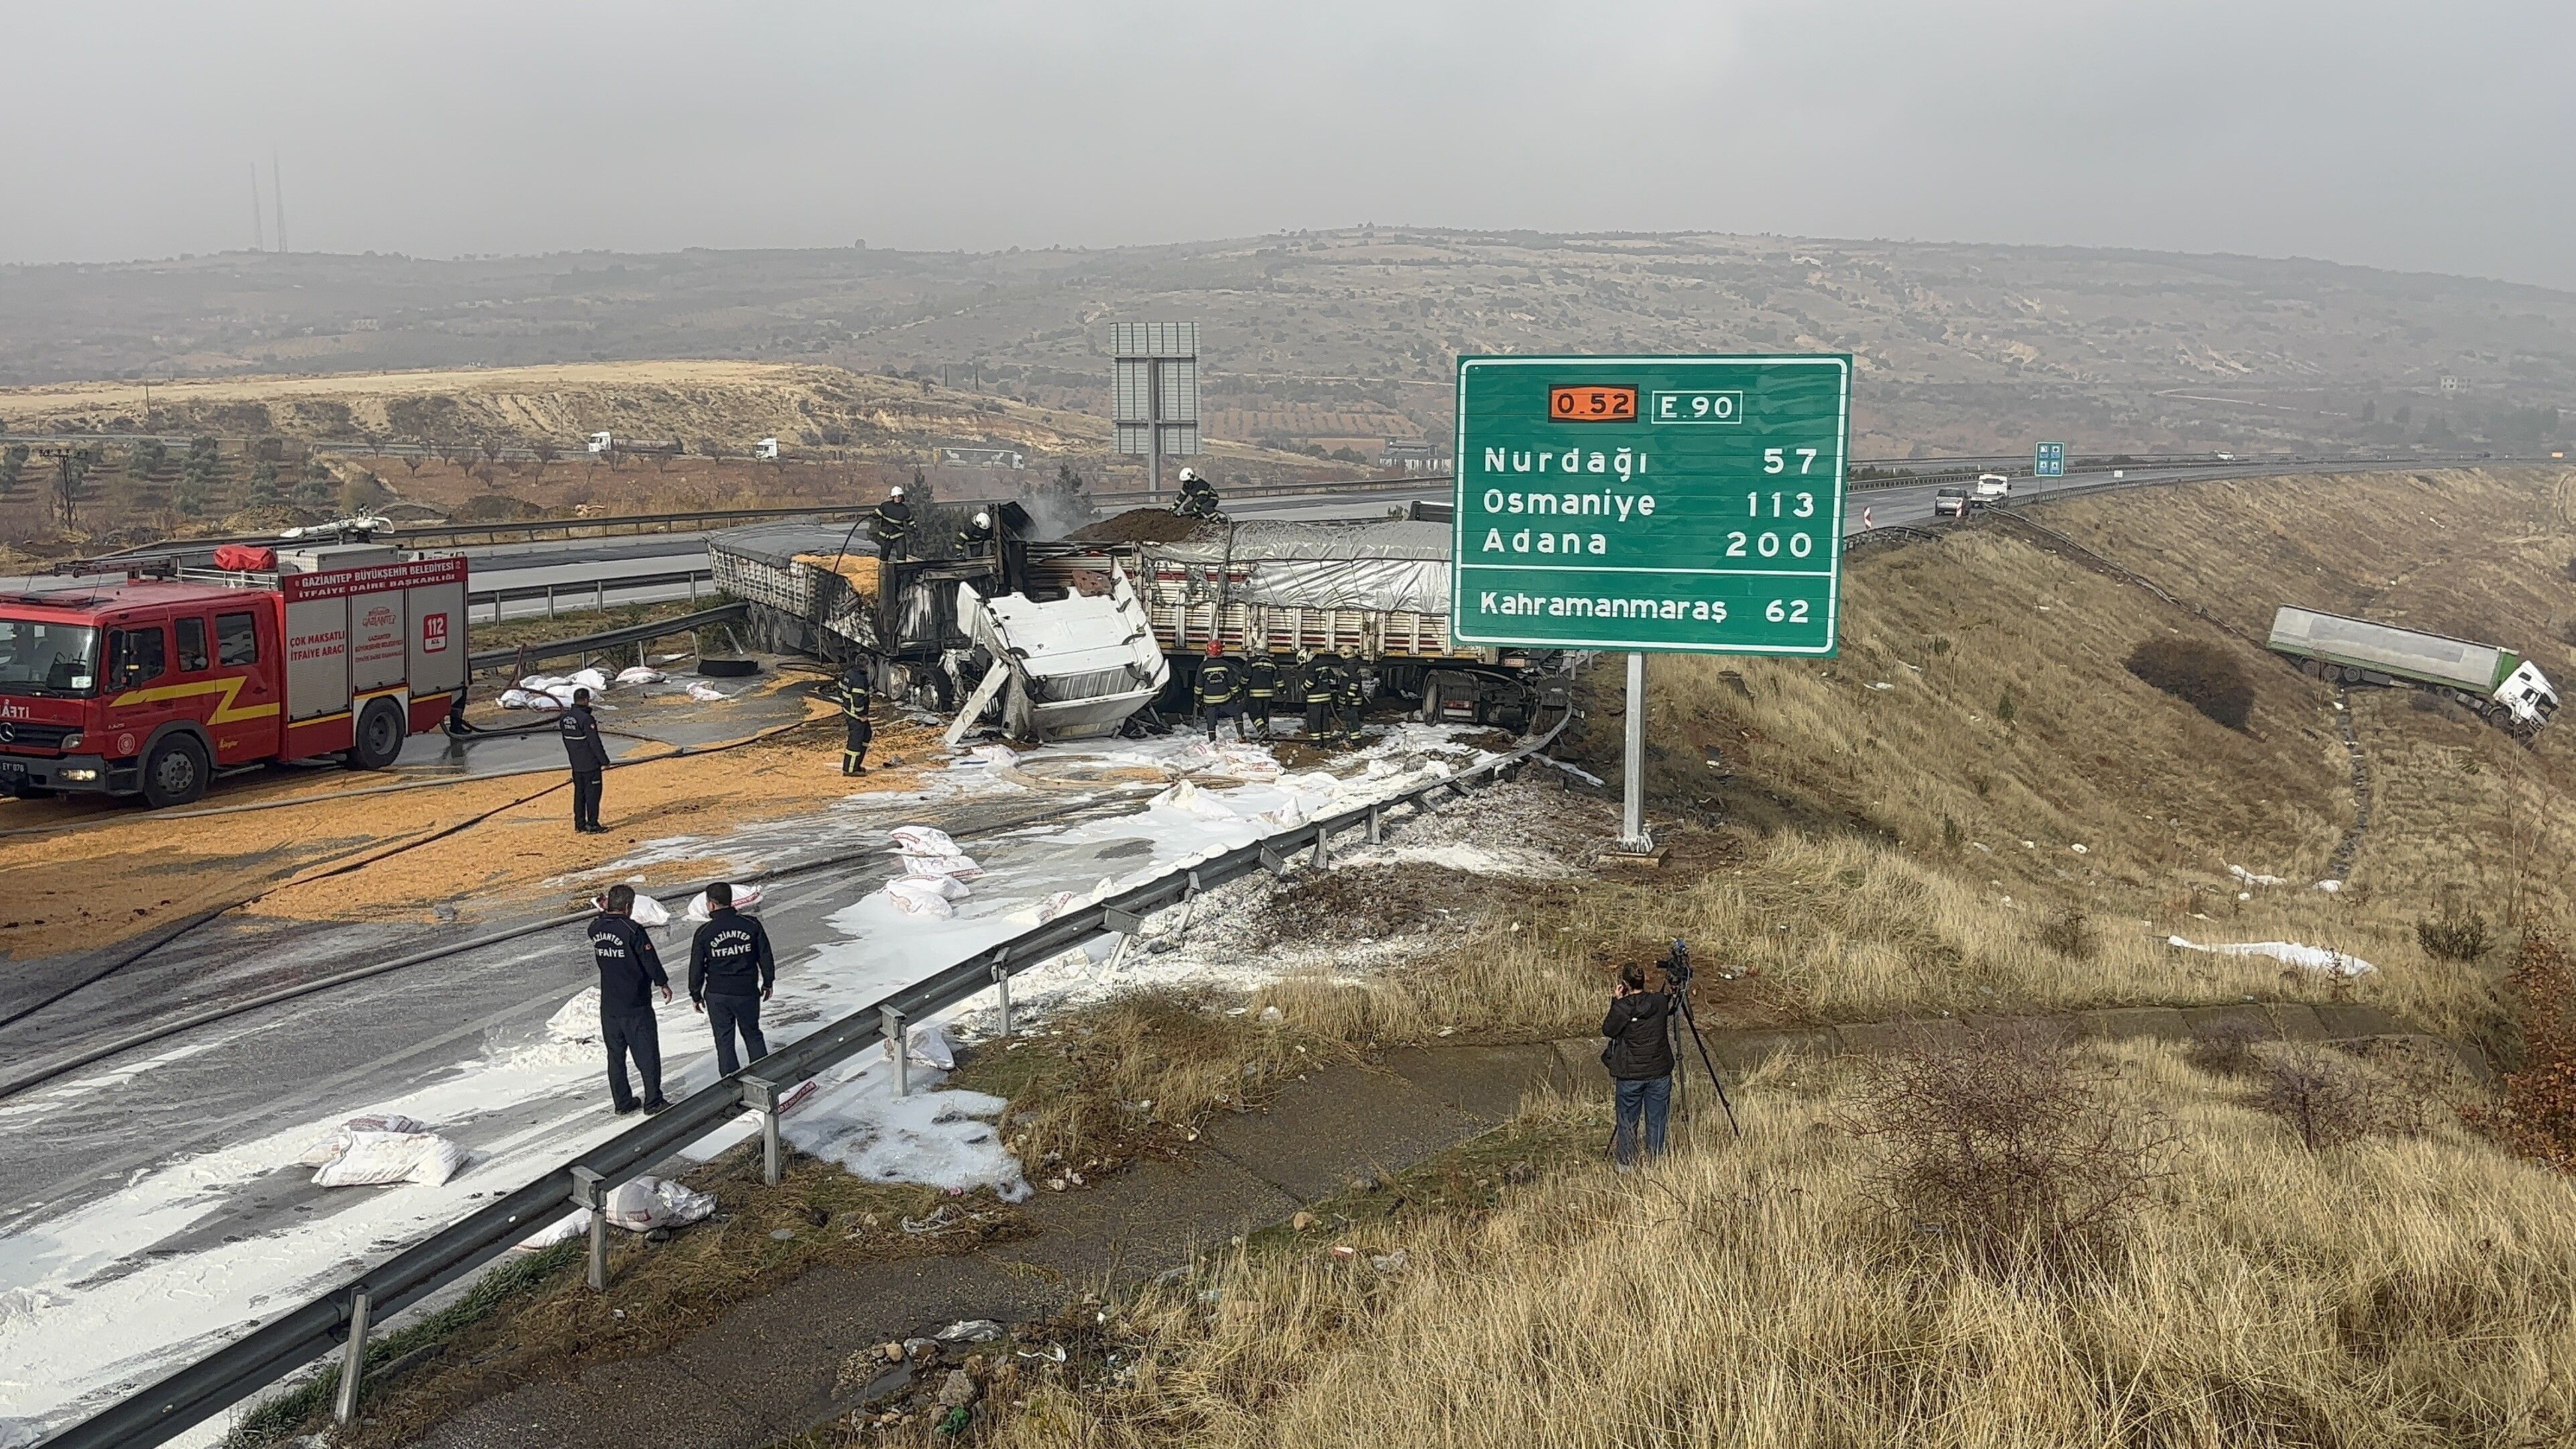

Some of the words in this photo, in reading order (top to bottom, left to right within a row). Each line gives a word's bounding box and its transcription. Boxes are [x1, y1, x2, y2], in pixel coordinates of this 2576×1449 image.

[1660, 396, 1733, 419] E.90
[1485, 447, 1647, 482] Nurdağı
[1764, 449, 1817, 474] 57
[1484, 488, 1656, 522] Osmaniye
[1748, 492, 1814, 518] 113
[1483, 528, 1606, 555] Adana
[1726, 532, 1812, 557] 200
[302, 571, 352, 588] GAZİANTEP
[355, 566, 407, 582] BÜYÜKŞEHİR
[410, 562, 454, 576] BELEDİYESİ
[299, 586, 345, 598] İTFAİYE
[1481, 592, 1727, 623] Kahramanmaraş
[1766, 600, 1809, 623] 62
[427, 616, 444, 636] 112
[290, 637, 307, 648] ÇOK
[308, 631, 345, 644] MAKSATLI
[290, 646, 321, 661] İTFAİYE
[322, 644, 345, 657] ARACI
[592, 931, 623, 947] AZİANTEP
[710, 929, 751, 948] GAZİANTEP
[711, 943, 752, 958] İTFAİYE
